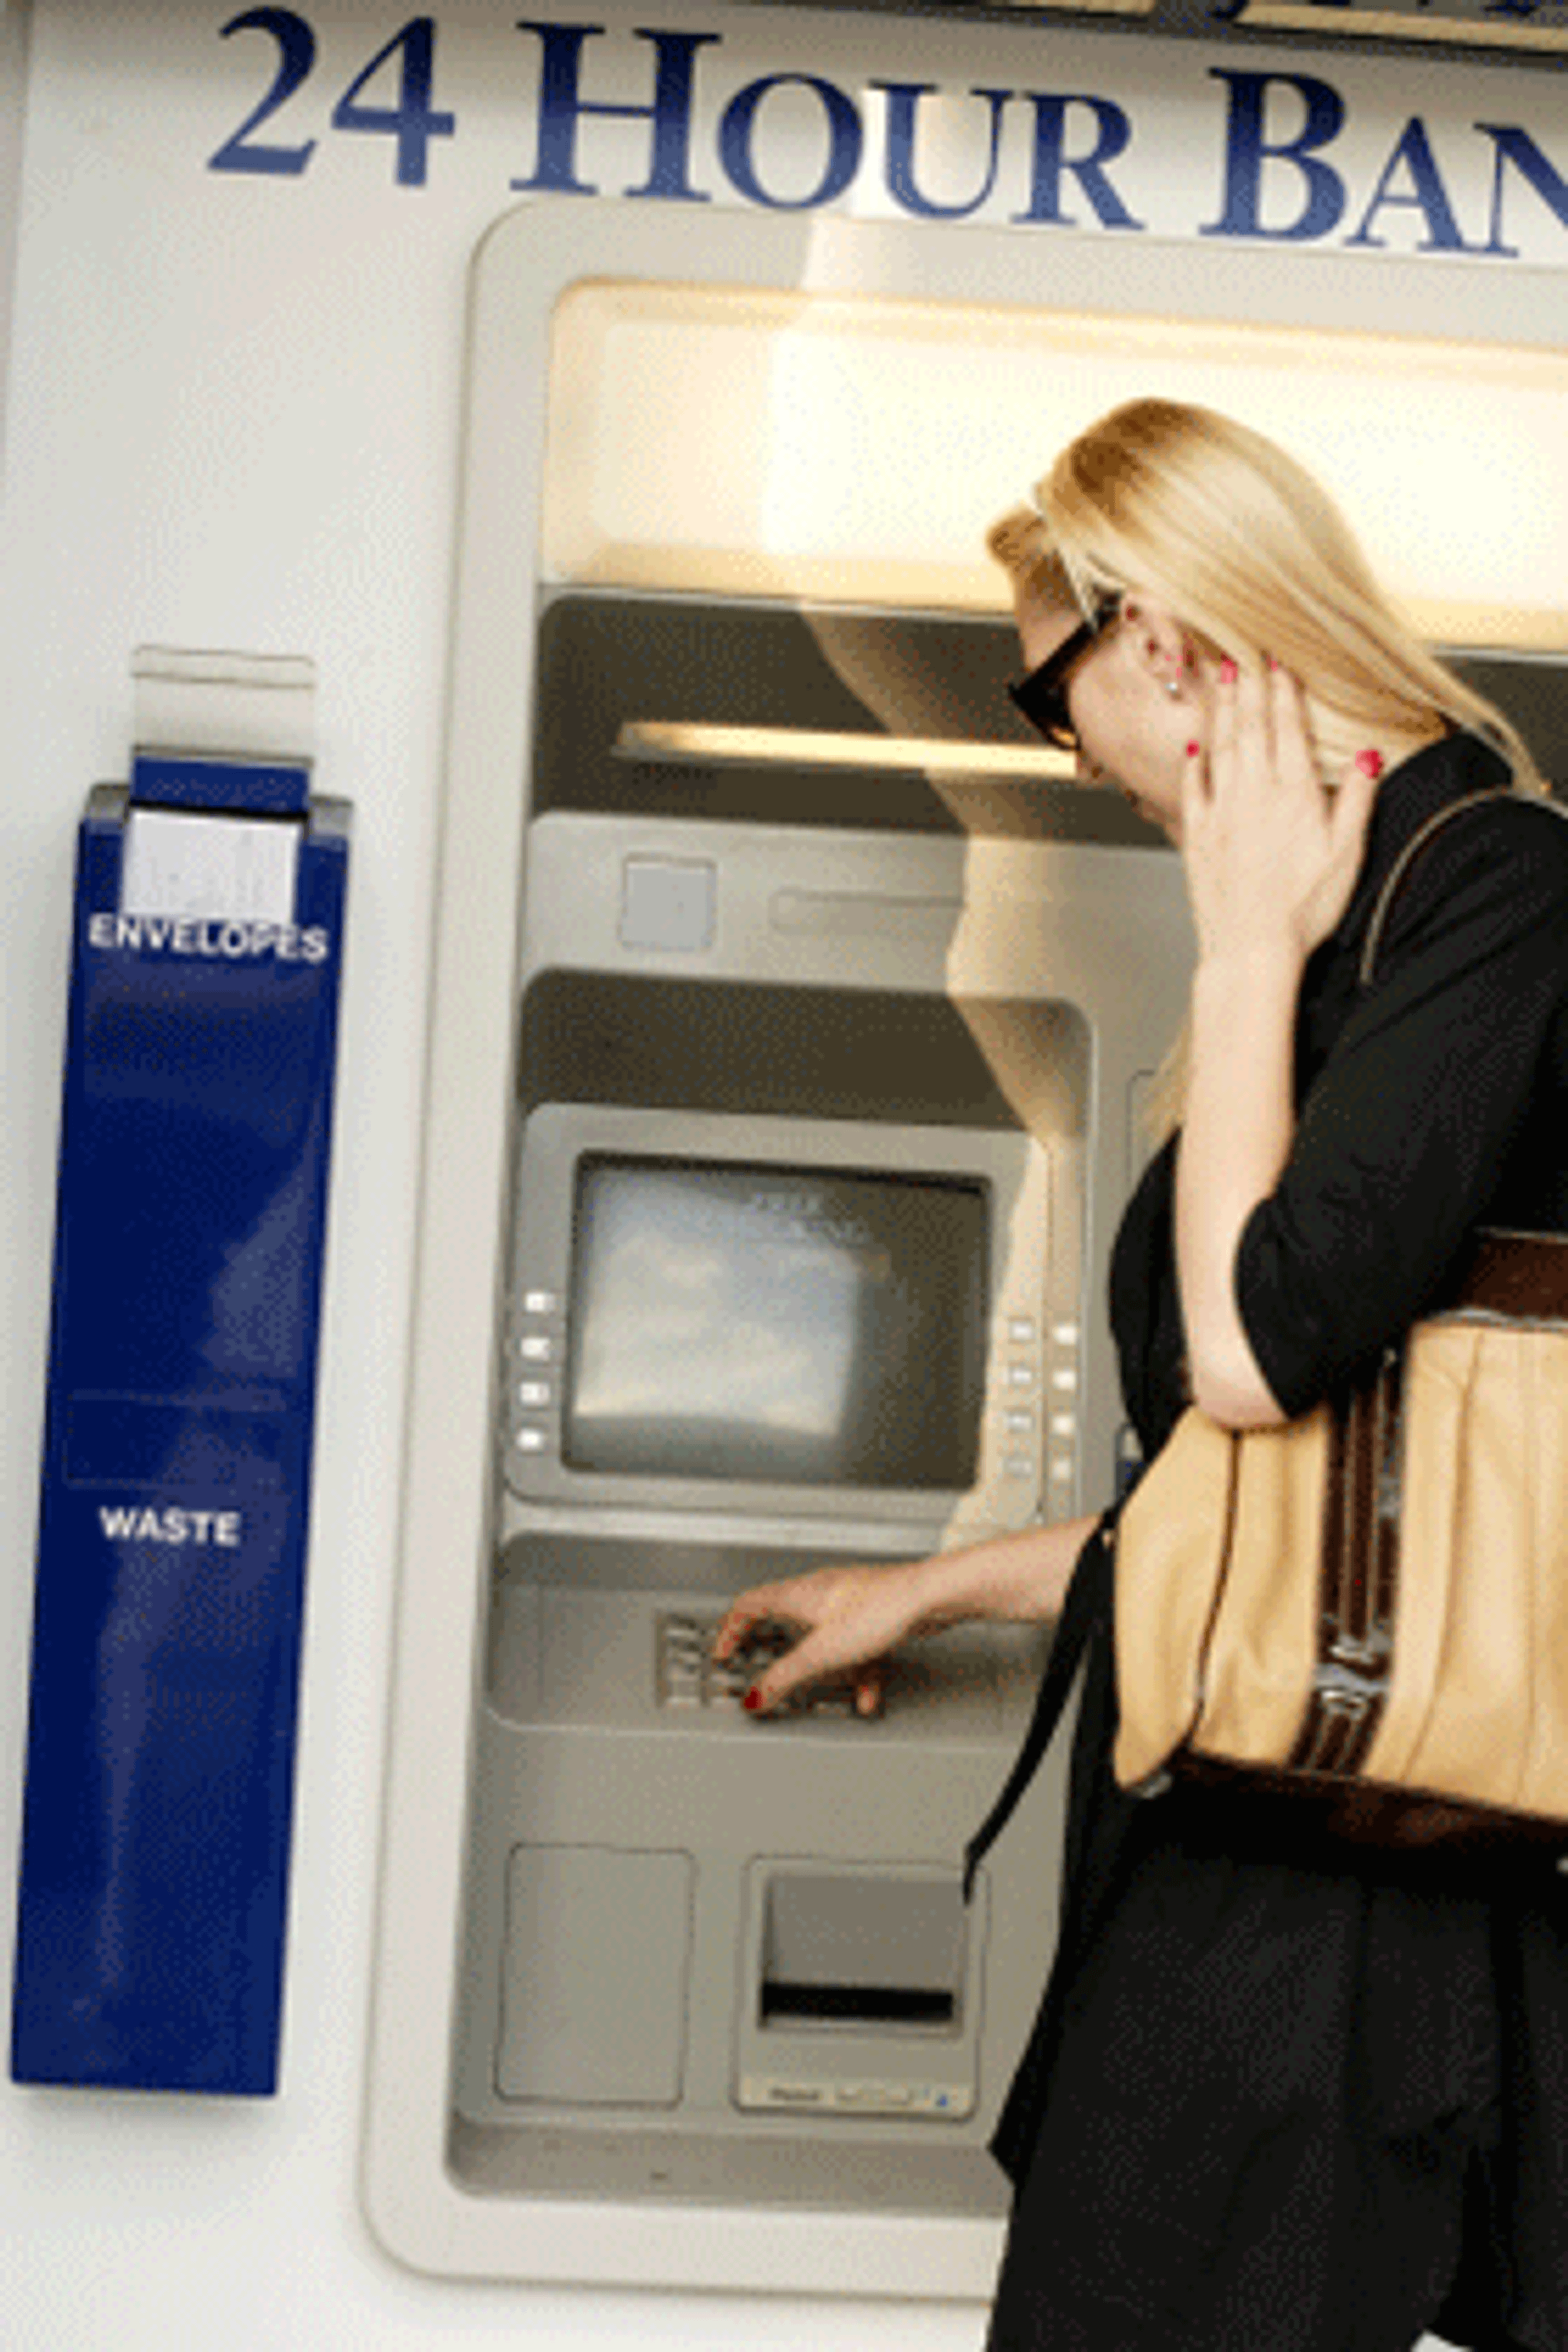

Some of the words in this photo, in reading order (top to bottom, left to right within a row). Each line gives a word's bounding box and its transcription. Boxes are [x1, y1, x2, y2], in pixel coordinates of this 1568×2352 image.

[207, 5, 456, 187] 24
[510, 20, 1145, 230] HOUR
[89, 912, 328, 962] ENVELOPES
[100, 1506, 241, 1546] WASTE
